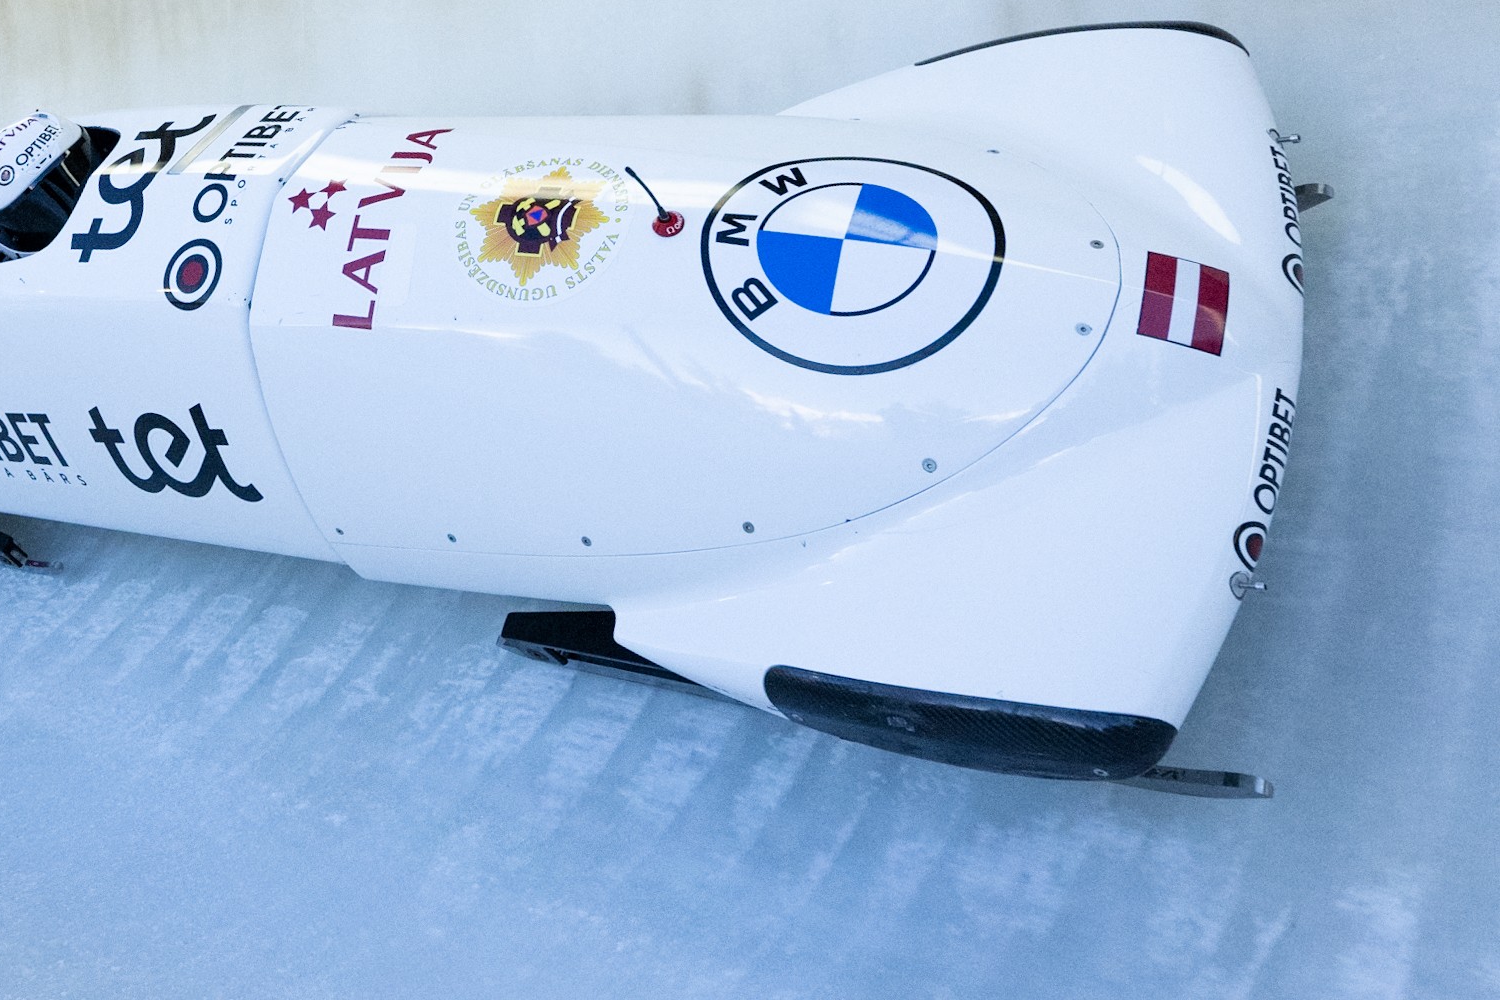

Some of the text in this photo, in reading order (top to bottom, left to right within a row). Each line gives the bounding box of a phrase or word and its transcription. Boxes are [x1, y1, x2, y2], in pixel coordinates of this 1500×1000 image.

[71, 114, 217, 263] tet
[332, 128, 456, 330] LATVIJA
[458, 193, 478, 212] UN
[587, 161, 629, 213] DIENESTS
[565, 233, 620, 290] VALSTS
[715, 167, 808, 321] BMW
[26, 468, 88, 487] BĀRS
[88, 402, 264, 502] tet
[1254, 387, 1296, 515] OPTIBET
